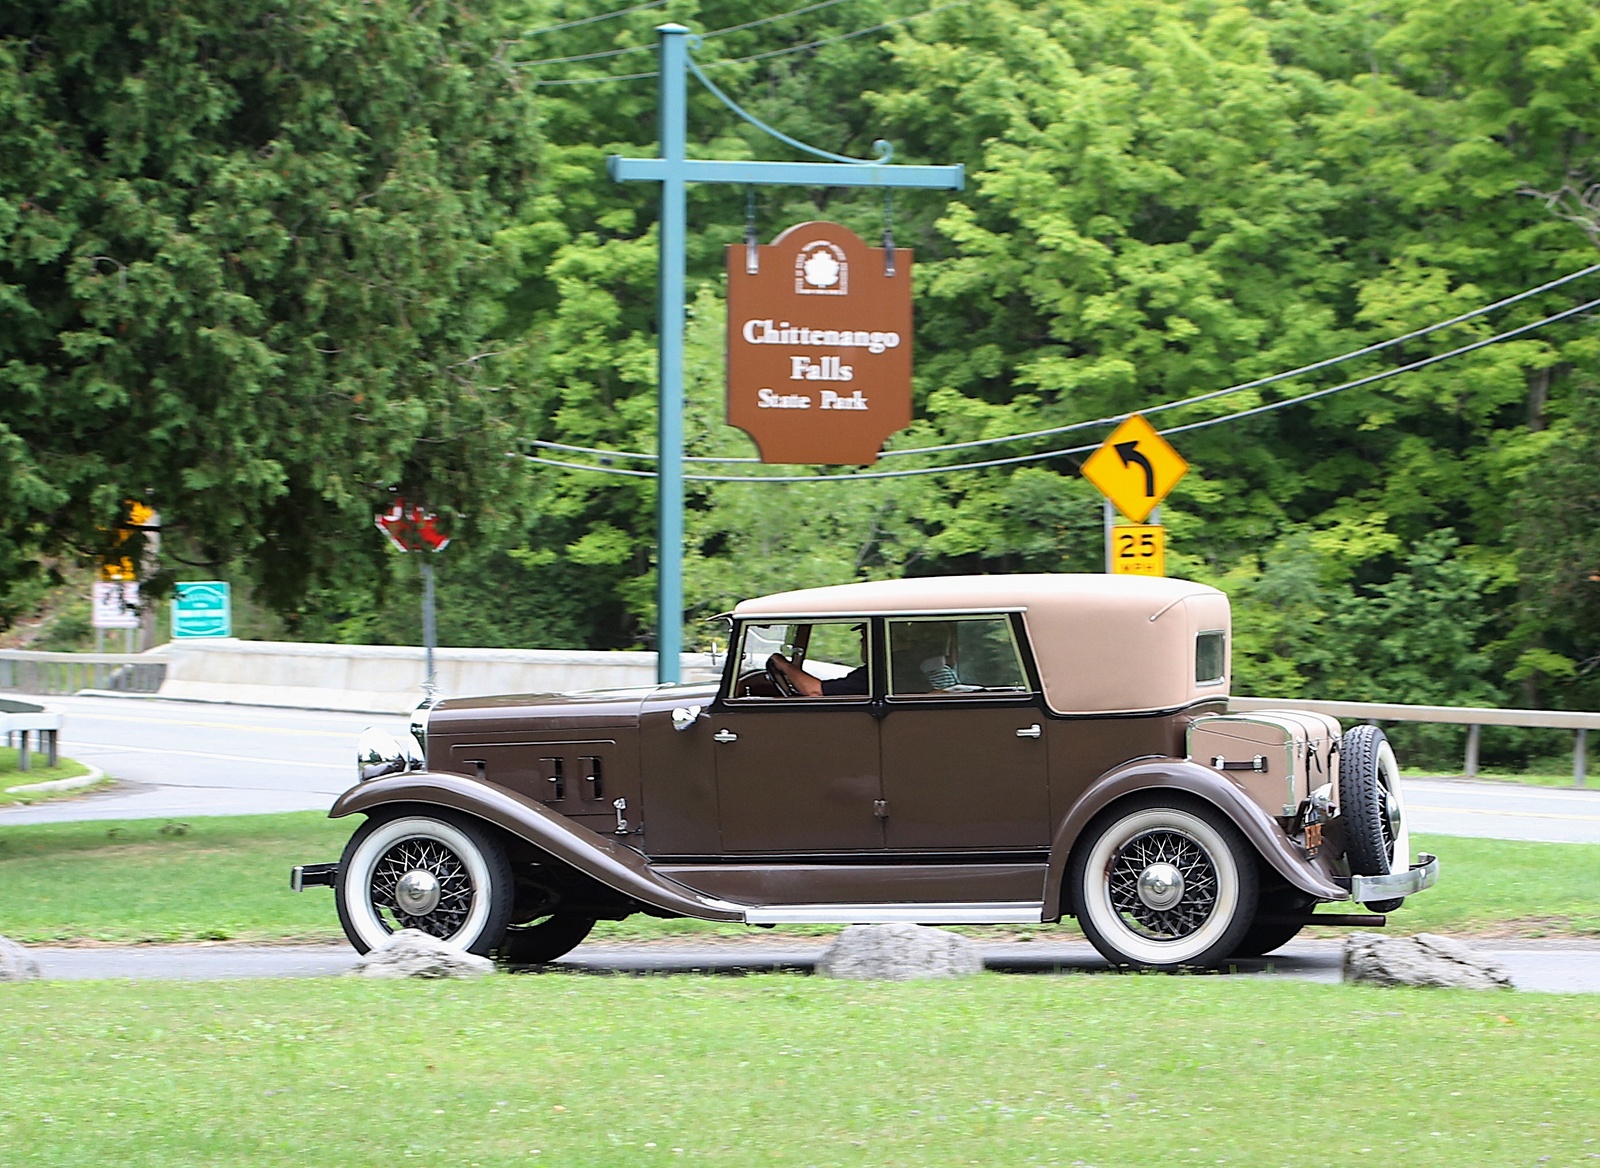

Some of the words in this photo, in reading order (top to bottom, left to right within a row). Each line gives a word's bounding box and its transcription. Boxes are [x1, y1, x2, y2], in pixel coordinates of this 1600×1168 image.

[742, 319, 900, 353] Chittenango
[790, 356, 853, 381] Falls
[757, 388, 811, 409] State
[819, 390, 869, 410] Park
[1119, 534, 1156, 558] 25
